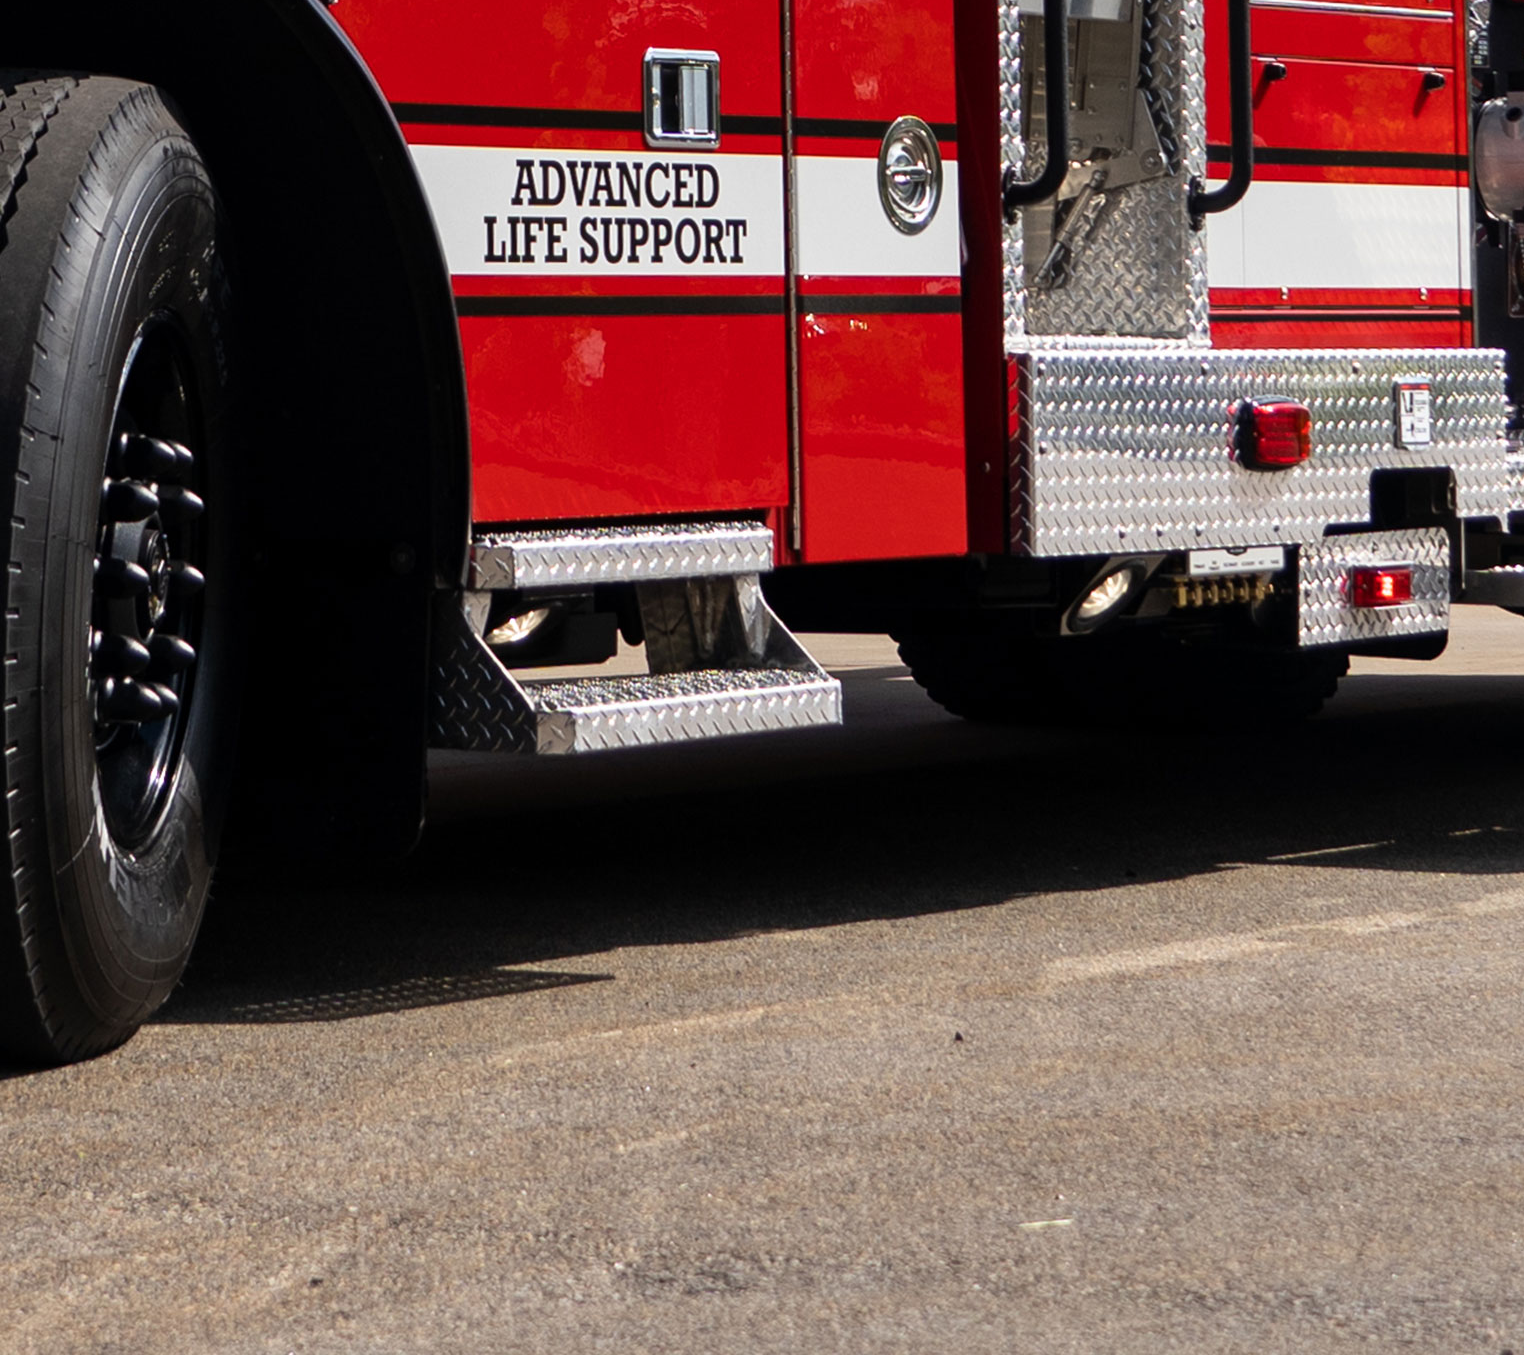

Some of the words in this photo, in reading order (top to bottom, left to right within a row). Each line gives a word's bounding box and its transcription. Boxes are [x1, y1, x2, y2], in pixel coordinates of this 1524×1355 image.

[511, 159, 720, 208] ADVANCED
[484, 216, 568, 263] LIFE
[579, 217, 747, 263] SUPPORT
